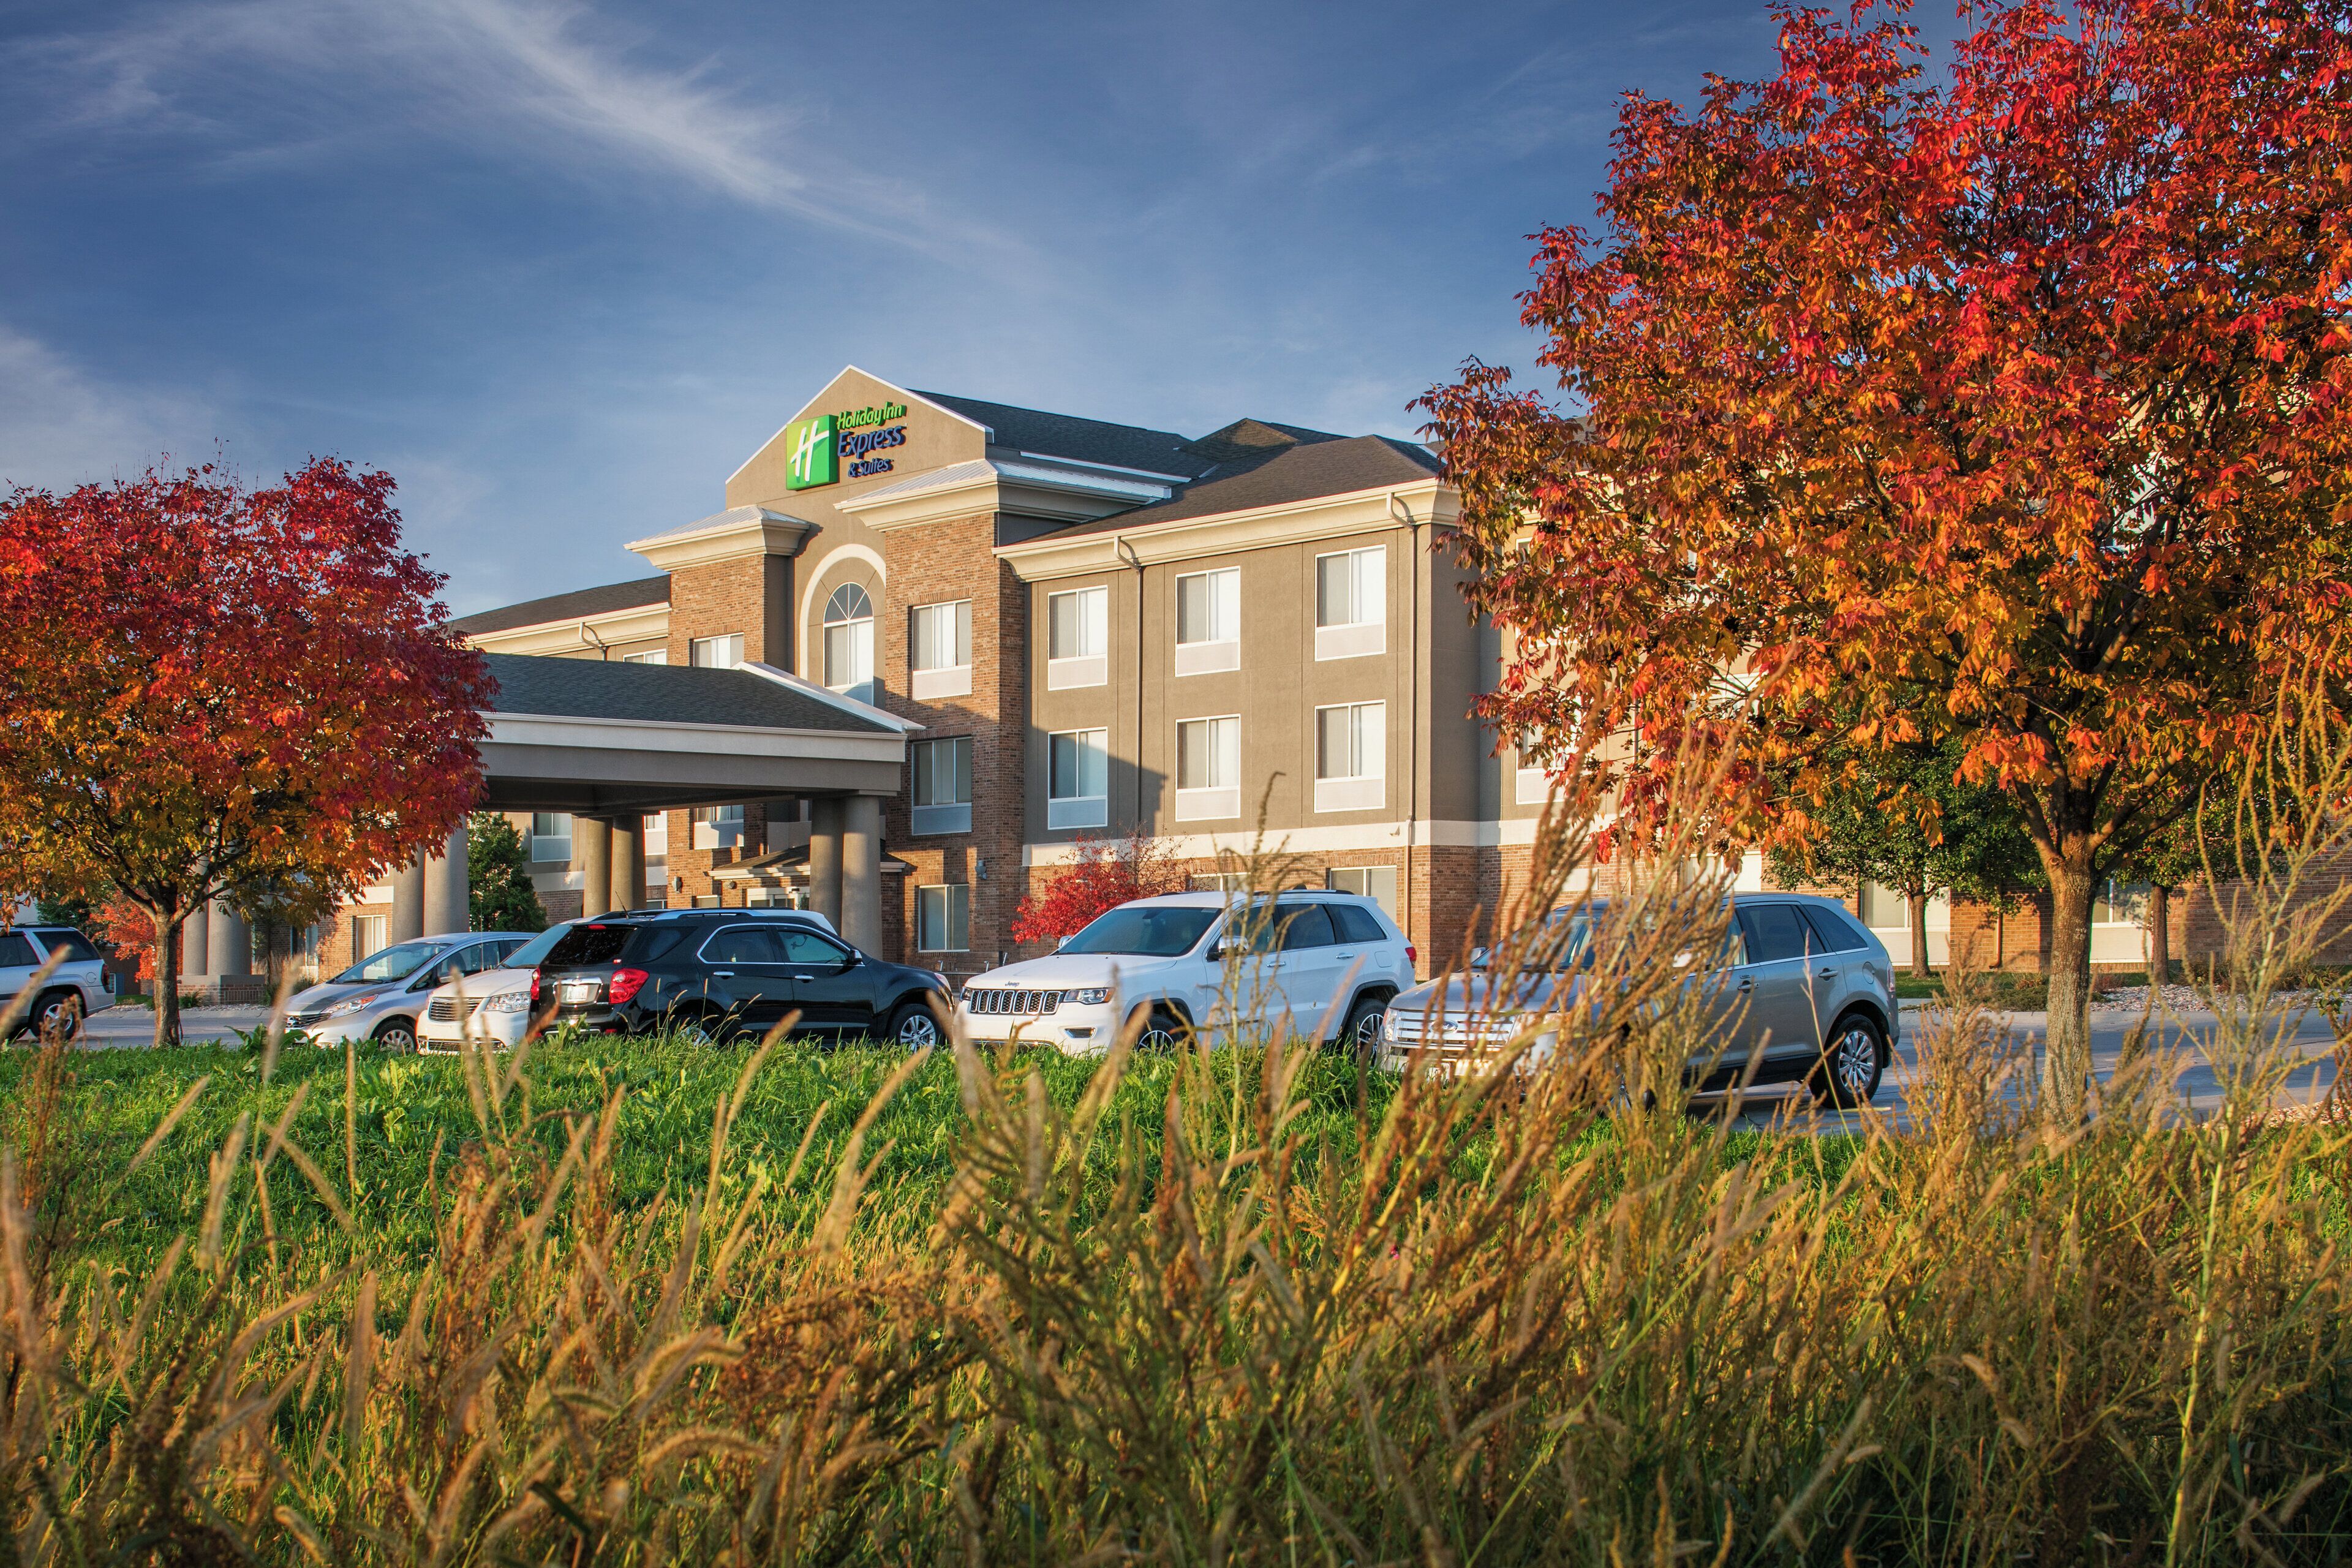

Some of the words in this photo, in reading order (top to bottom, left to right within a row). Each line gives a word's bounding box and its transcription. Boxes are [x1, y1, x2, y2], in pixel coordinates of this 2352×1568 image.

[837, 407, 883, 430] Holiday
[883, 401, 905, 420] Inn
[837, 426, 903, 459] Express
[848, 462, 858, 477] &
[858, 458, 891, 477] Suites
